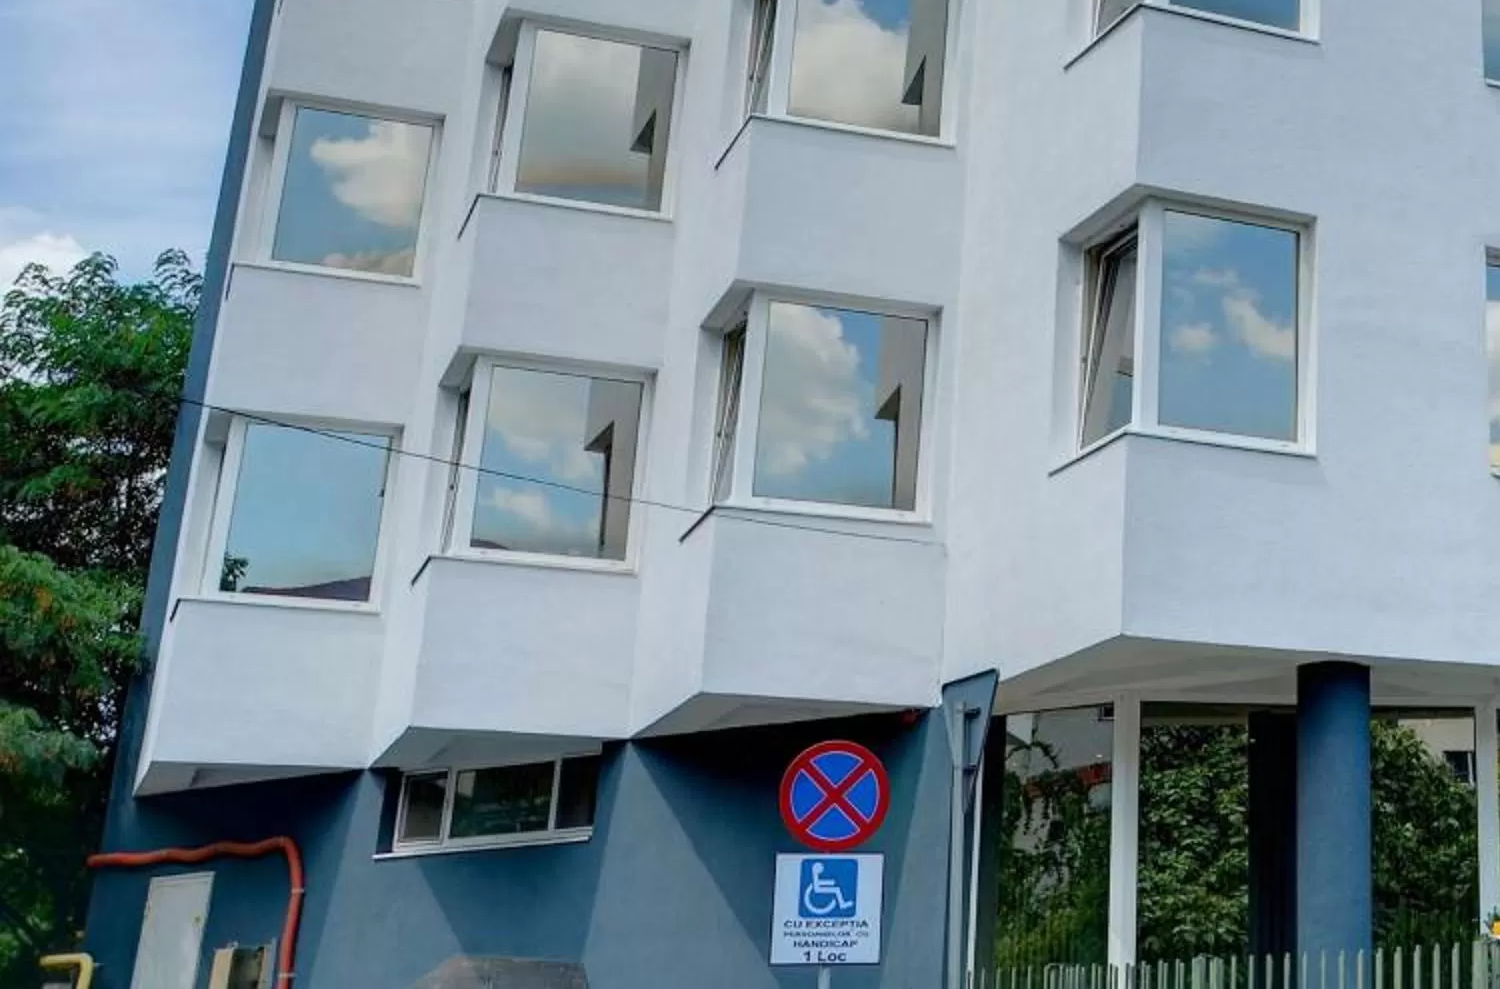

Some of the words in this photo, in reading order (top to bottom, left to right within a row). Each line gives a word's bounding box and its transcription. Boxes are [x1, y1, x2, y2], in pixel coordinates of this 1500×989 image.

[783, 920, 803, 928] CU
[793, 940, 858, 948] HANDICAP
[803, 950, 811, 962] 1
